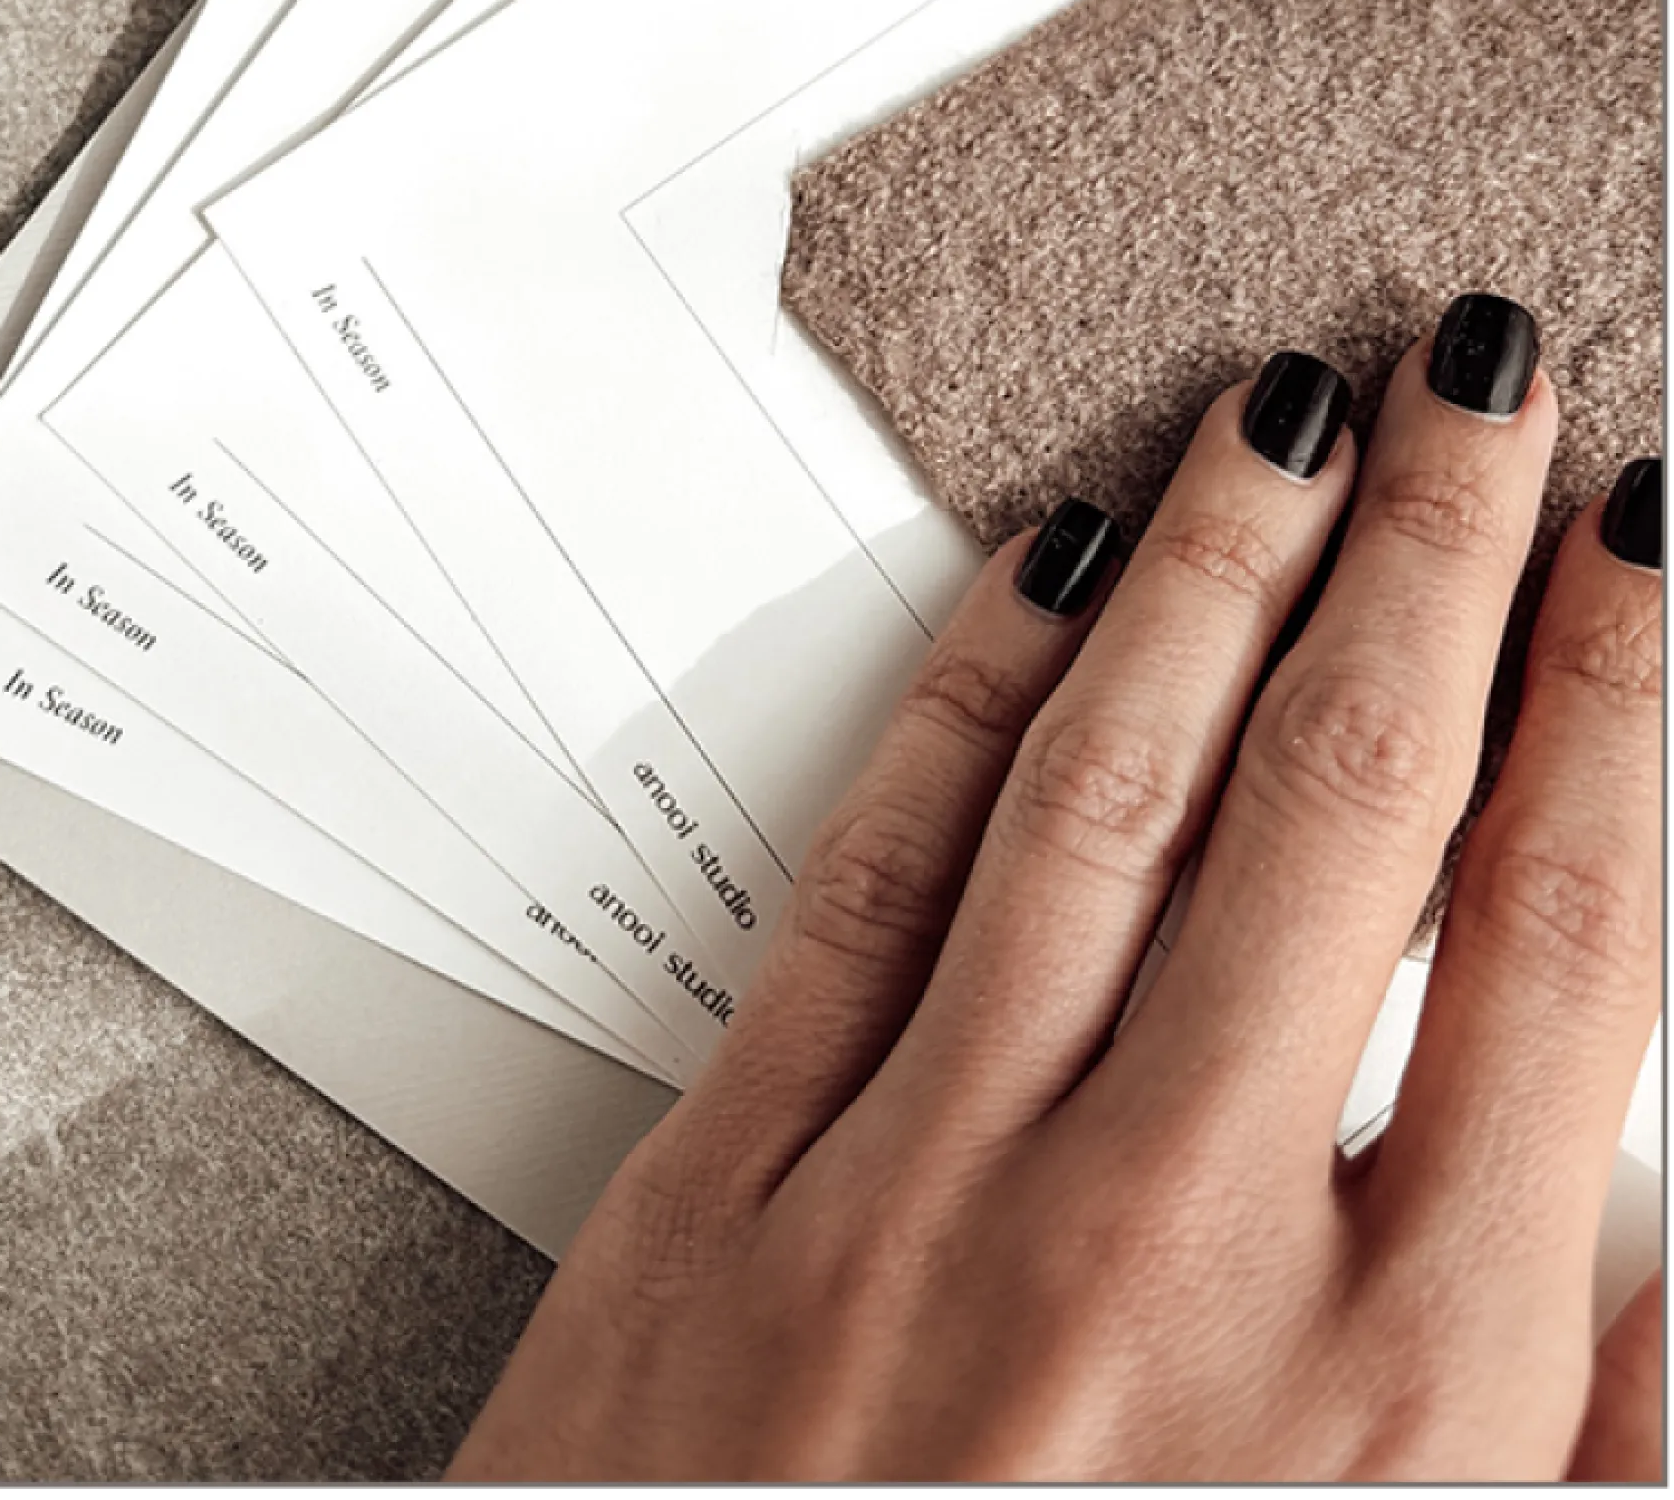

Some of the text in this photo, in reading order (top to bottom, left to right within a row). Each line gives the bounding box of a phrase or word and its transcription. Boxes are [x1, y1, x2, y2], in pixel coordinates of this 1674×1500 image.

[310, 282, 391, 393] In Season
[168, 472, 268, 573] In Season
[45, 561, 157, 652] In Season
[2, 667, 124, 745] In Season
[633, 761, 757, 931] anooi studio
[525, 902, 598, 963] ano
[588, 882, 667, 954] anooi
